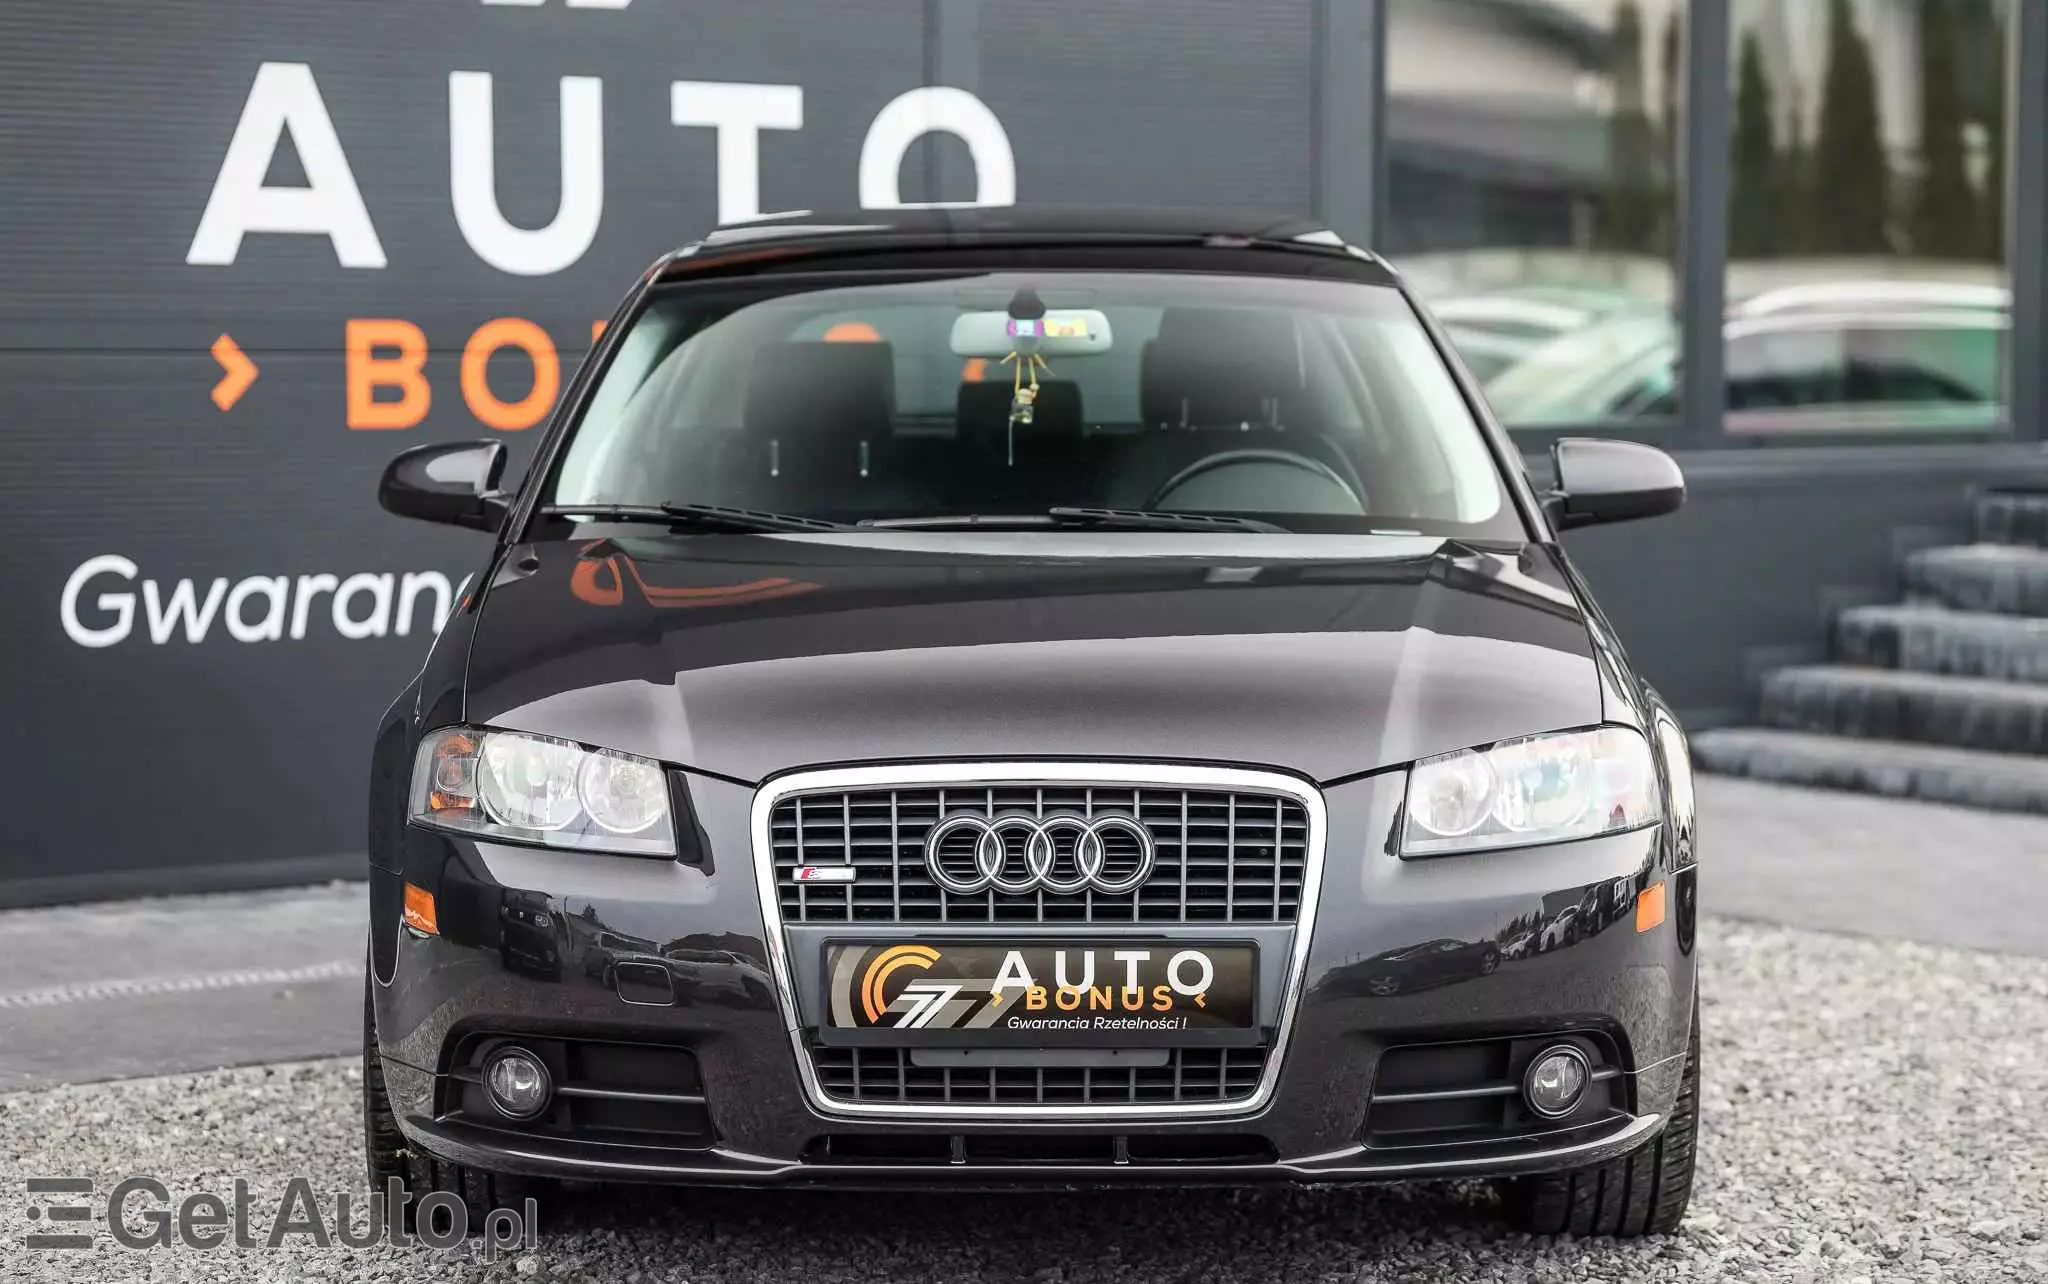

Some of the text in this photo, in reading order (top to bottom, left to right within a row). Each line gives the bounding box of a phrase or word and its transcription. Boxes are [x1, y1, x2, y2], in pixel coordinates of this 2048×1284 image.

[186, 62, 1016, 275] AUTO
[346, 317, 608, 431] BO
[61, 555, 474, 648] Gwaran
[990, 950, 1214, 997] AUTO
[1026, 985, 1174, 1012] BONUS
[1007, 1016, 1090, 1030] Gwarancia
[1093, 1015, 1179, 1030] Rzetelności
